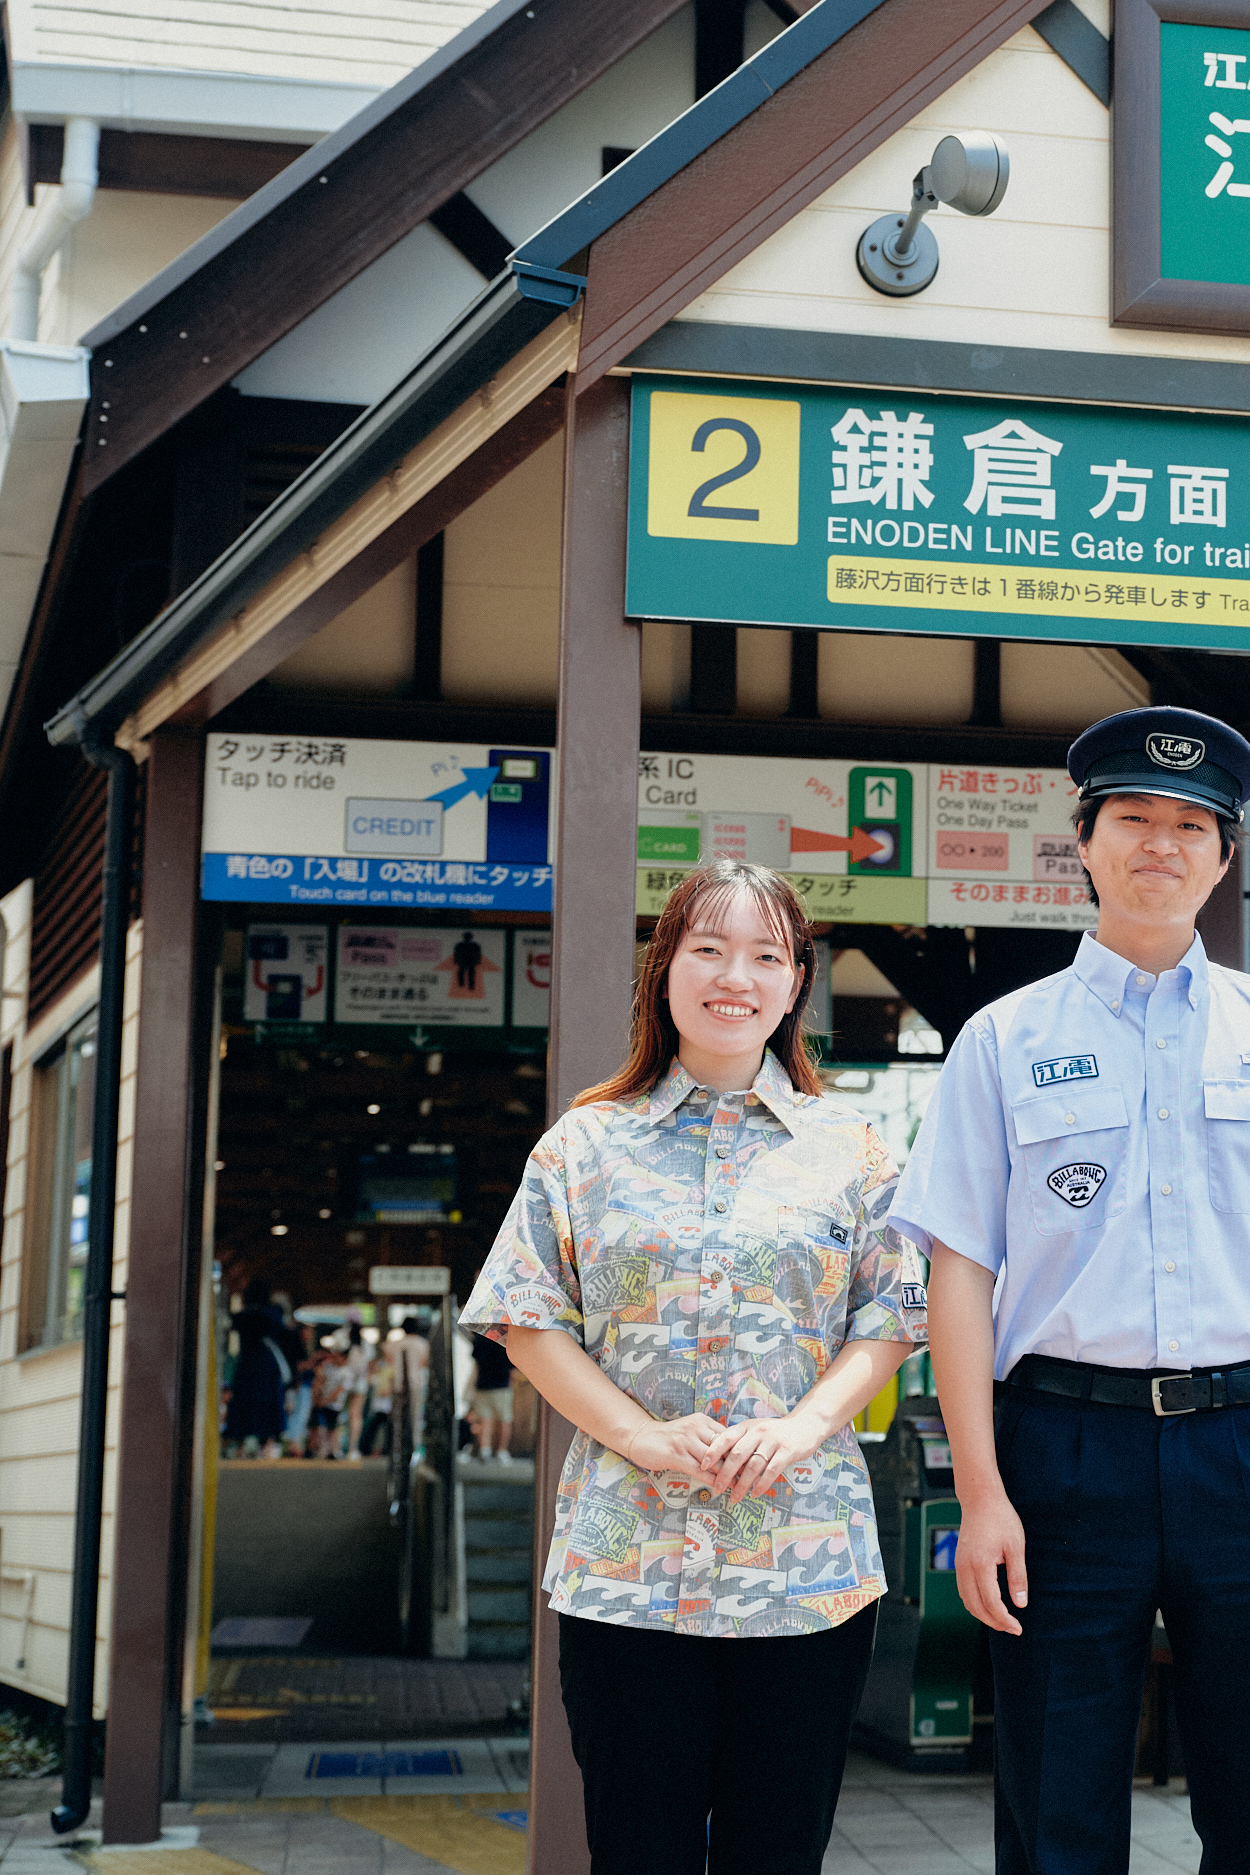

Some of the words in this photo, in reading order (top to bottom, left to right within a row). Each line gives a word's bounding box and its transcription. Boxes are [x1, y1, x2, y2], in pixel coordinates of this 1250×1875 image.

[686, 417, 762, 521] 2
[827, 517, 973, 551] ENODEN
[985, 526, 1060, 557] LINE
[1071, 533, 1144, 561] Gate
[1153, 537, 1195, 565] for
[216, 739, 346, 768] タッチ決済
[217, 766, 259, 791] Tap
[266, 769, 288, 789] to
[294, 769, 336, 790] ride
[645, 785, 698, 805] Card
[937, 796, 964, 811] One
[967, 798, 997, 813] Way
[1001, 799, 1039, 813] Ticket
[352, 815, 436, 837] CREDIT
[937, 812, 964, 826] One
[967, 814, 994, 829] Day
[997, 815, 1029, 829] Pass
[1045, 859, 1084, 874] Pas
[289, 885, 331, 900] Touch
[335, 887, 367, 901] card
[370, 890, 387, 902] on
[391, 888, 412, 902] the
[416, 889, 446, 903] blue
[449, 892, 494, 906] reader
[1009, 911, 1037, 923] Just
[1040, 912, 1067, 924] walk
[1071, 912, 1099, 925] thro
[648, 1142, 706, 1165] BILLABON
[1051, 1166, 1102, 1190] BILLABONG
[645, 1366, 696, 1400] BILLABON
